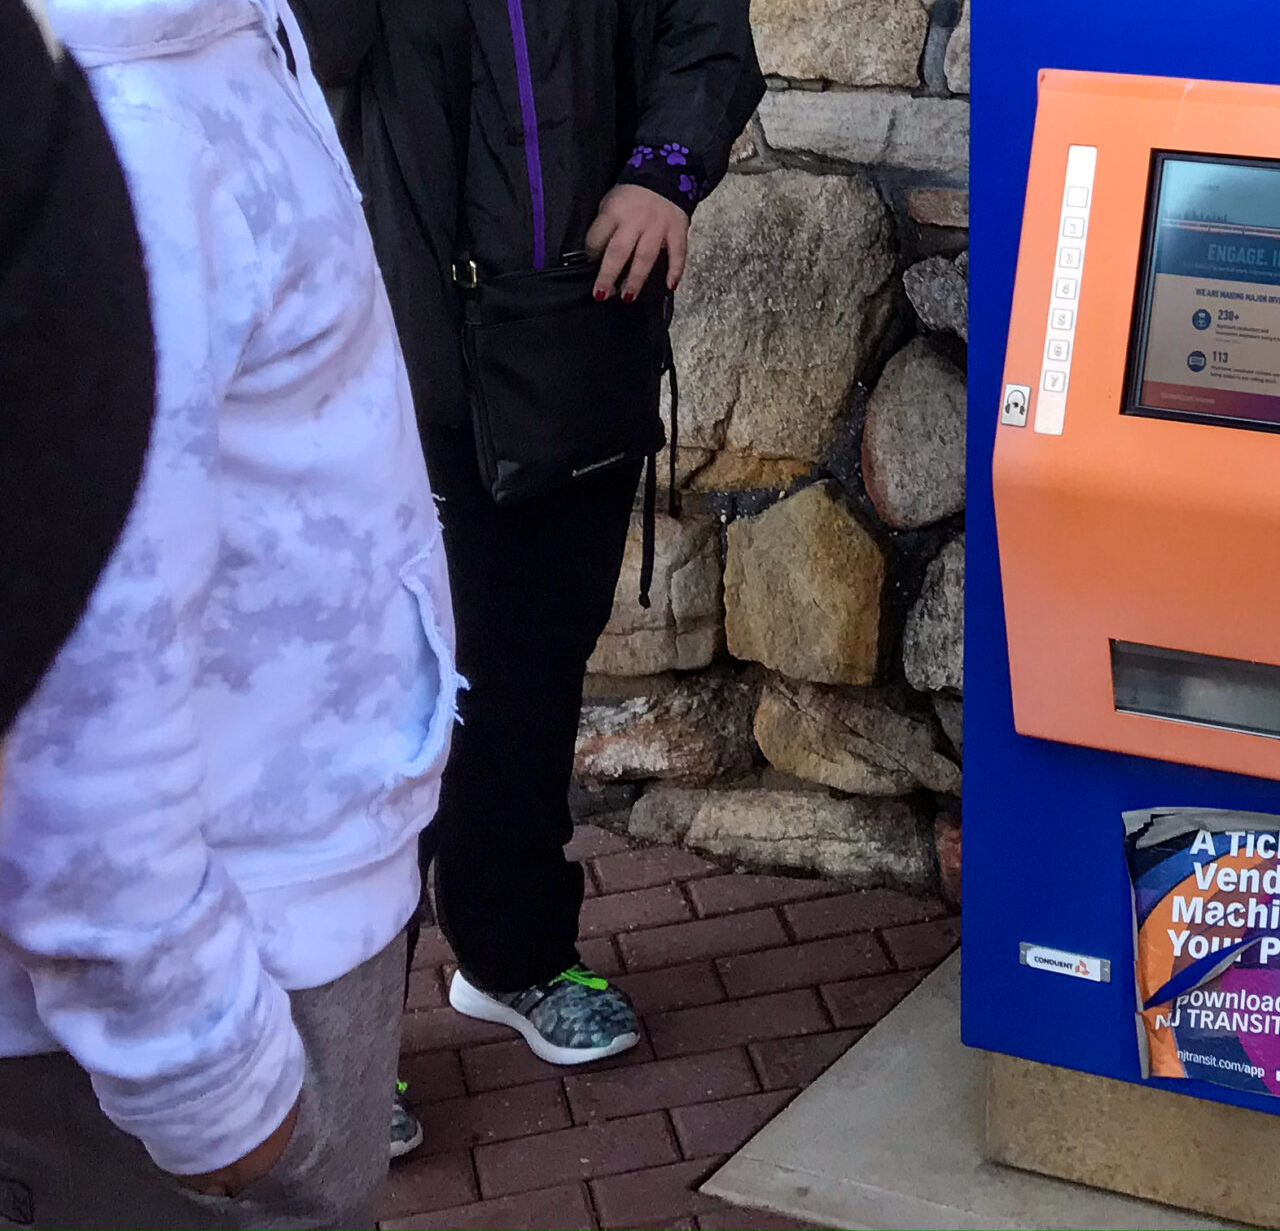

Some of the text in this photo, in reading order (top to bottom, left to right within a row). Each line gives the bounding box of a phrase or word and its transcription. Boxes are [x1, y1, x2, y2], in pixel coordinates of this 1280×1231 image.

[1207, 243, 1268, 267] ENGAGE.
[1245, 293, 1267, 303] MAJOR
[1218, 309, 1239, 321] 230+
[1212, 351, 1229, 363] 113
[1190, 830, 1217, 856] A
[1034, 955, 1073, 970] CONDUENT
[1154, 1008, 1180, 1031] NJ
[1177, 1049, 1265, 1079] njtransit.com/app
